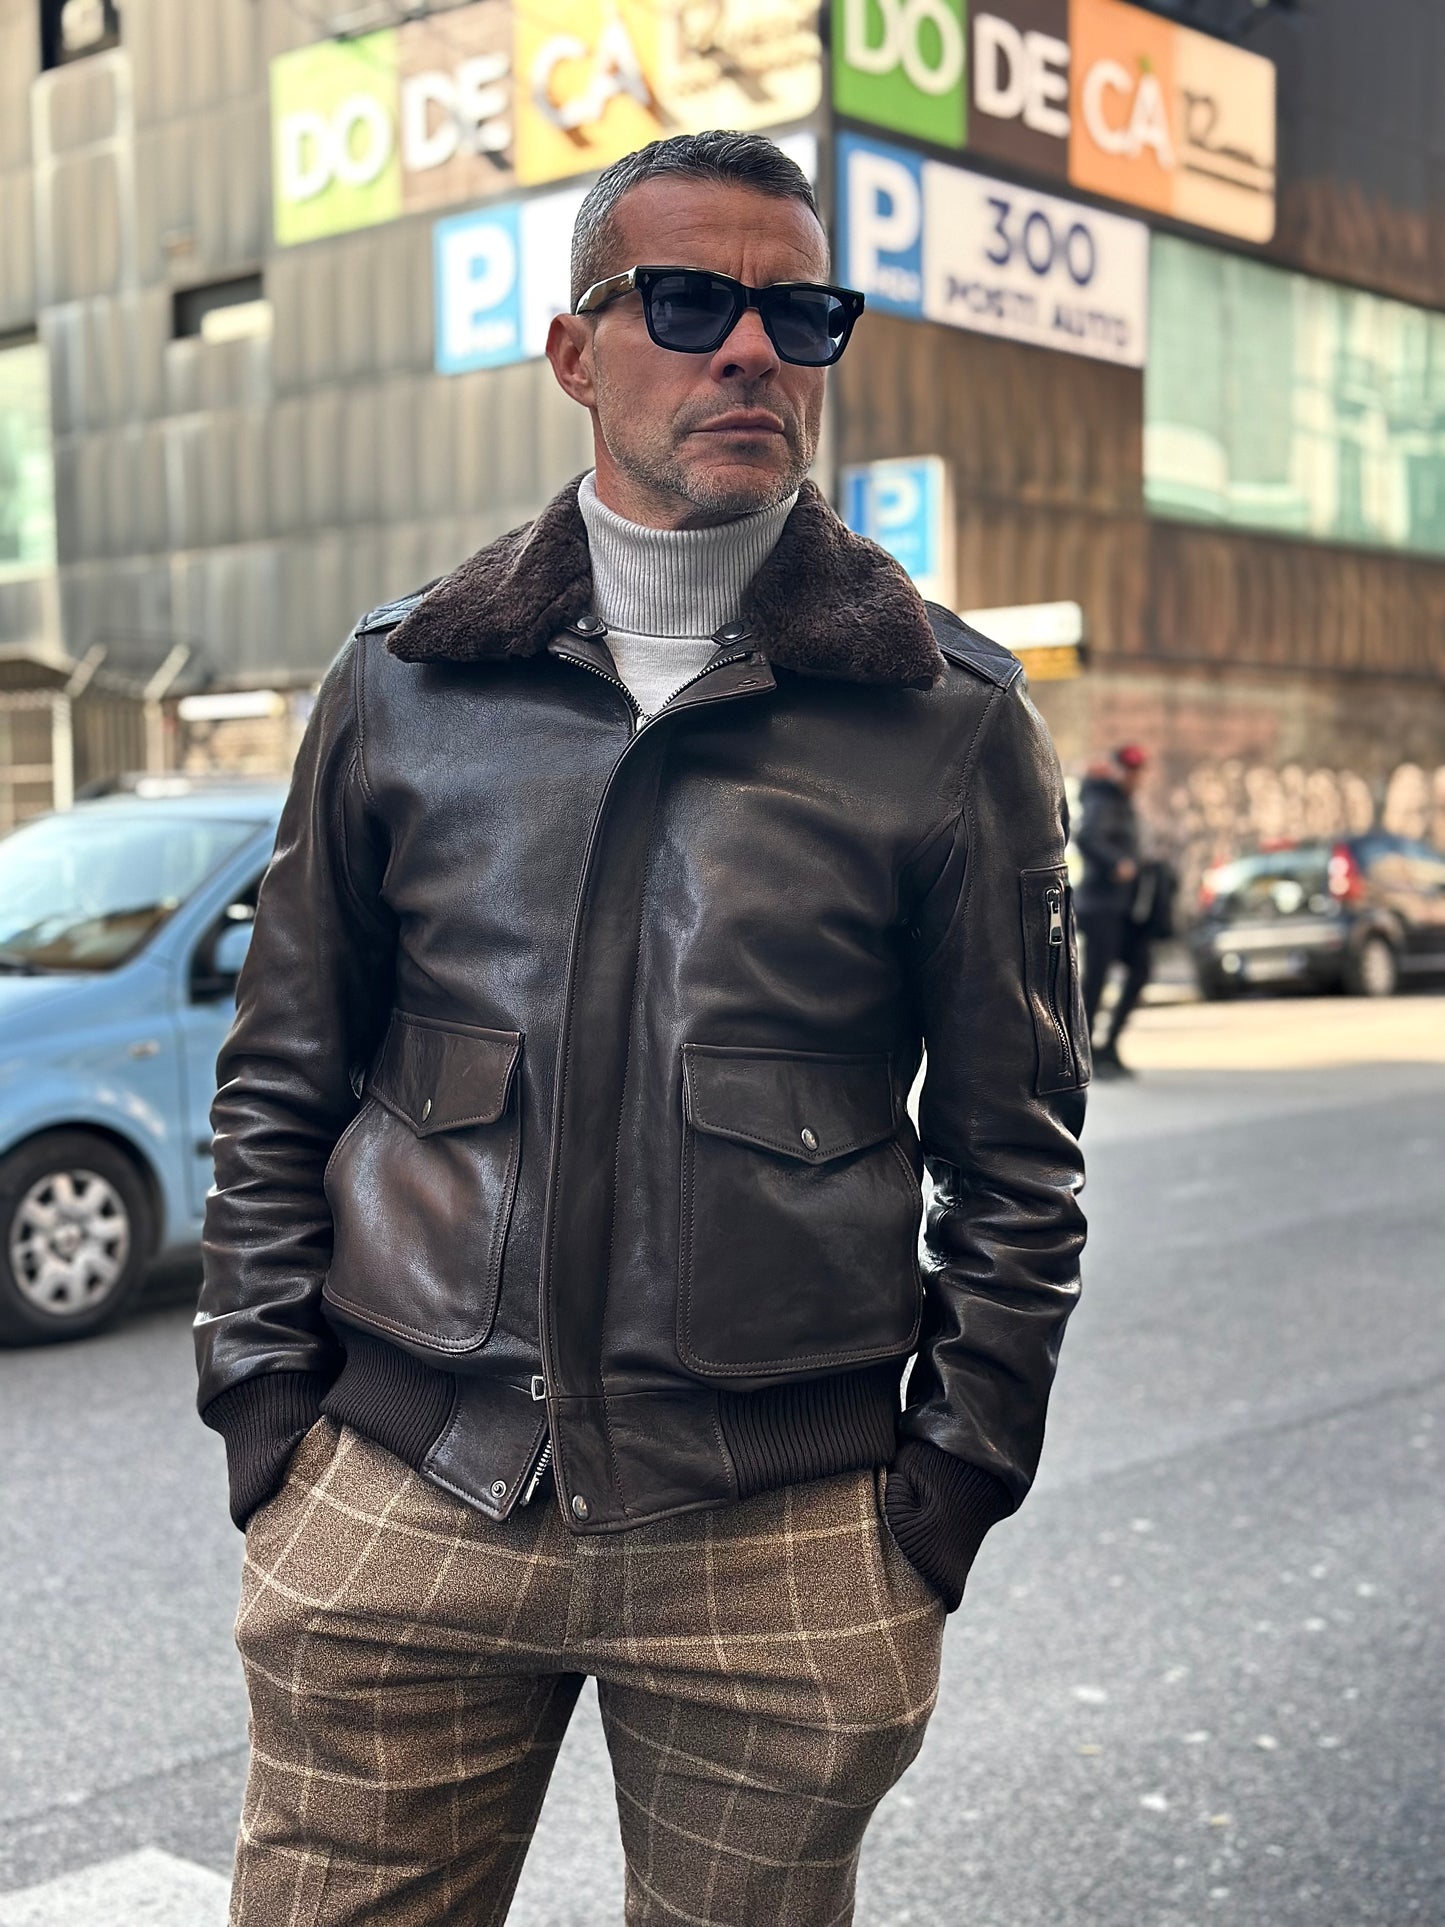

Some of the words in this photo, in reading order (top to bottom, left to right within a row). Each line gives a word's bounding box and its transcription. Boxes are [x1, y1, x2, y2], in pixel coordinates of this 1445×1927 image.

[848, 151, 924, 292] P
[985, 195, 1097, 287] 300
[441, 223, 517, 358] P
